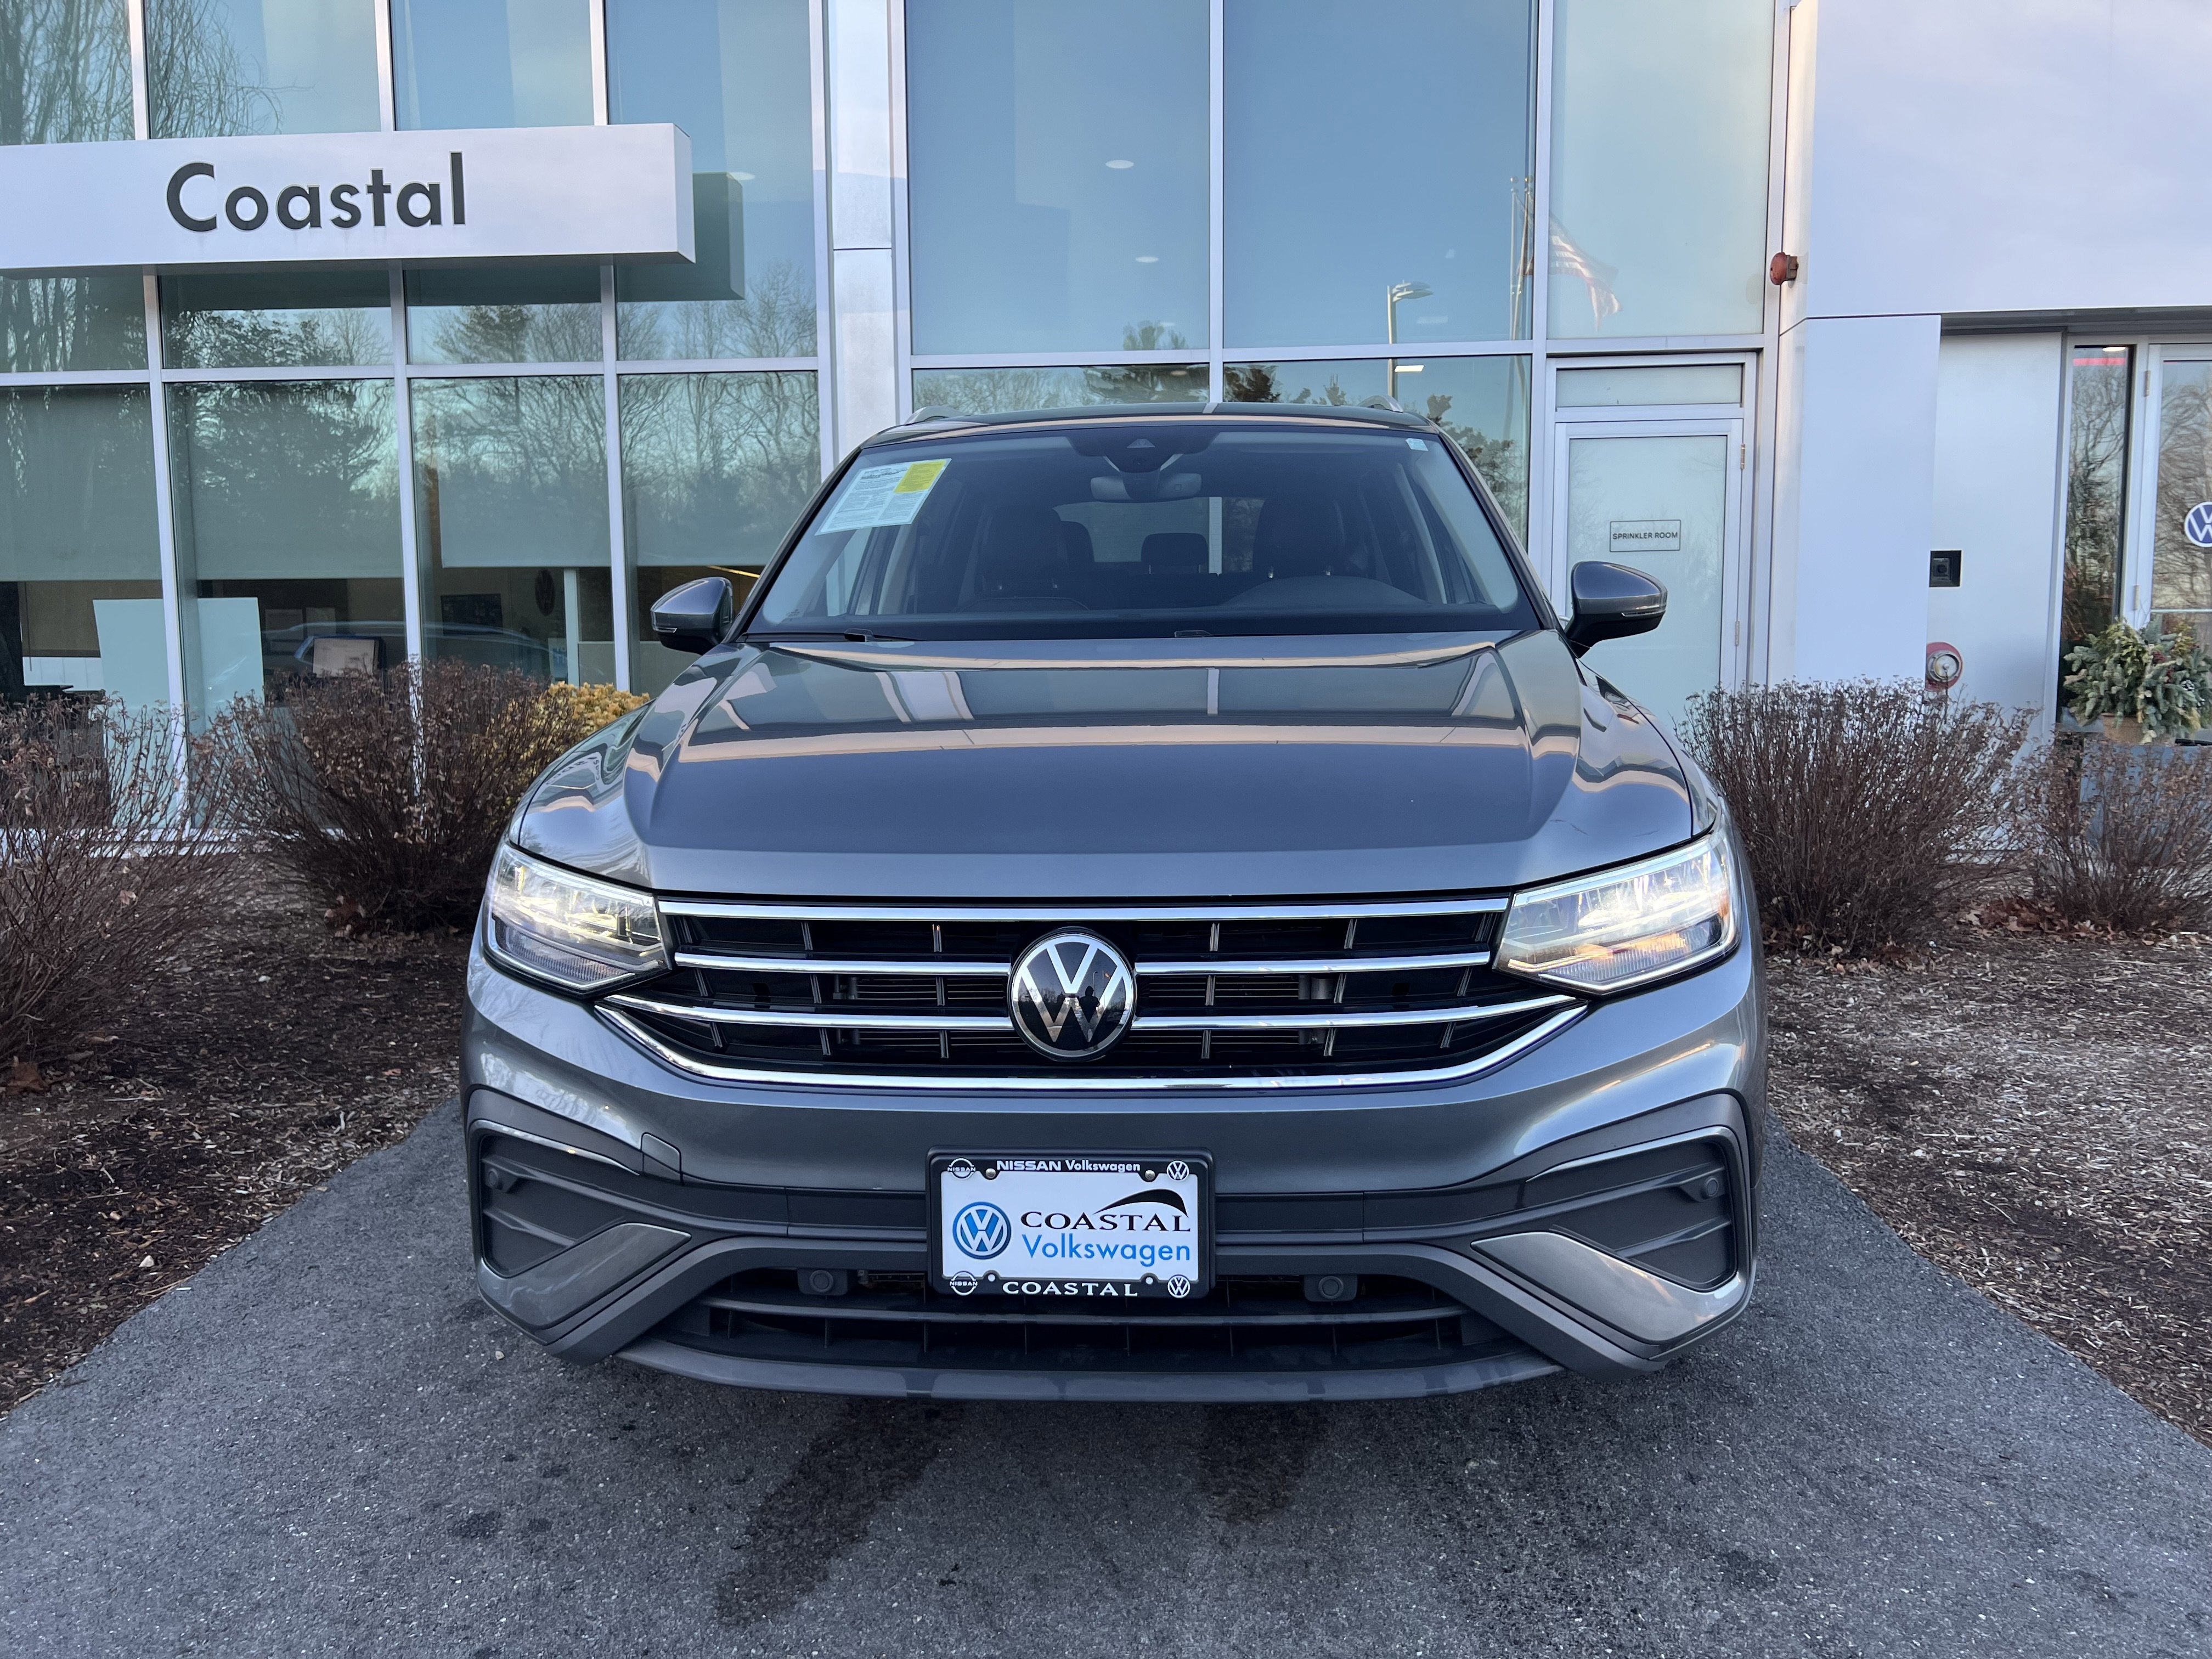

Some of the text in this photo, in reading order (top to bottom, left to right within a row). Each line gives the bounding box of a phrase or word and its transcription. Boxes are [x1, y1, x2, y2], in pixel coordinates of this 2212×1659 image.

[166, 150, 466, 232] Coastal
[996, 1159, 1141, 1173] NISSAN Volkswagen
[1020, 1211, 1190, 1232] COASTAL
[1022, 1233, 1190, 1267] Volkswagen
[1002, 1282, 1138, 1296] COASTAL
